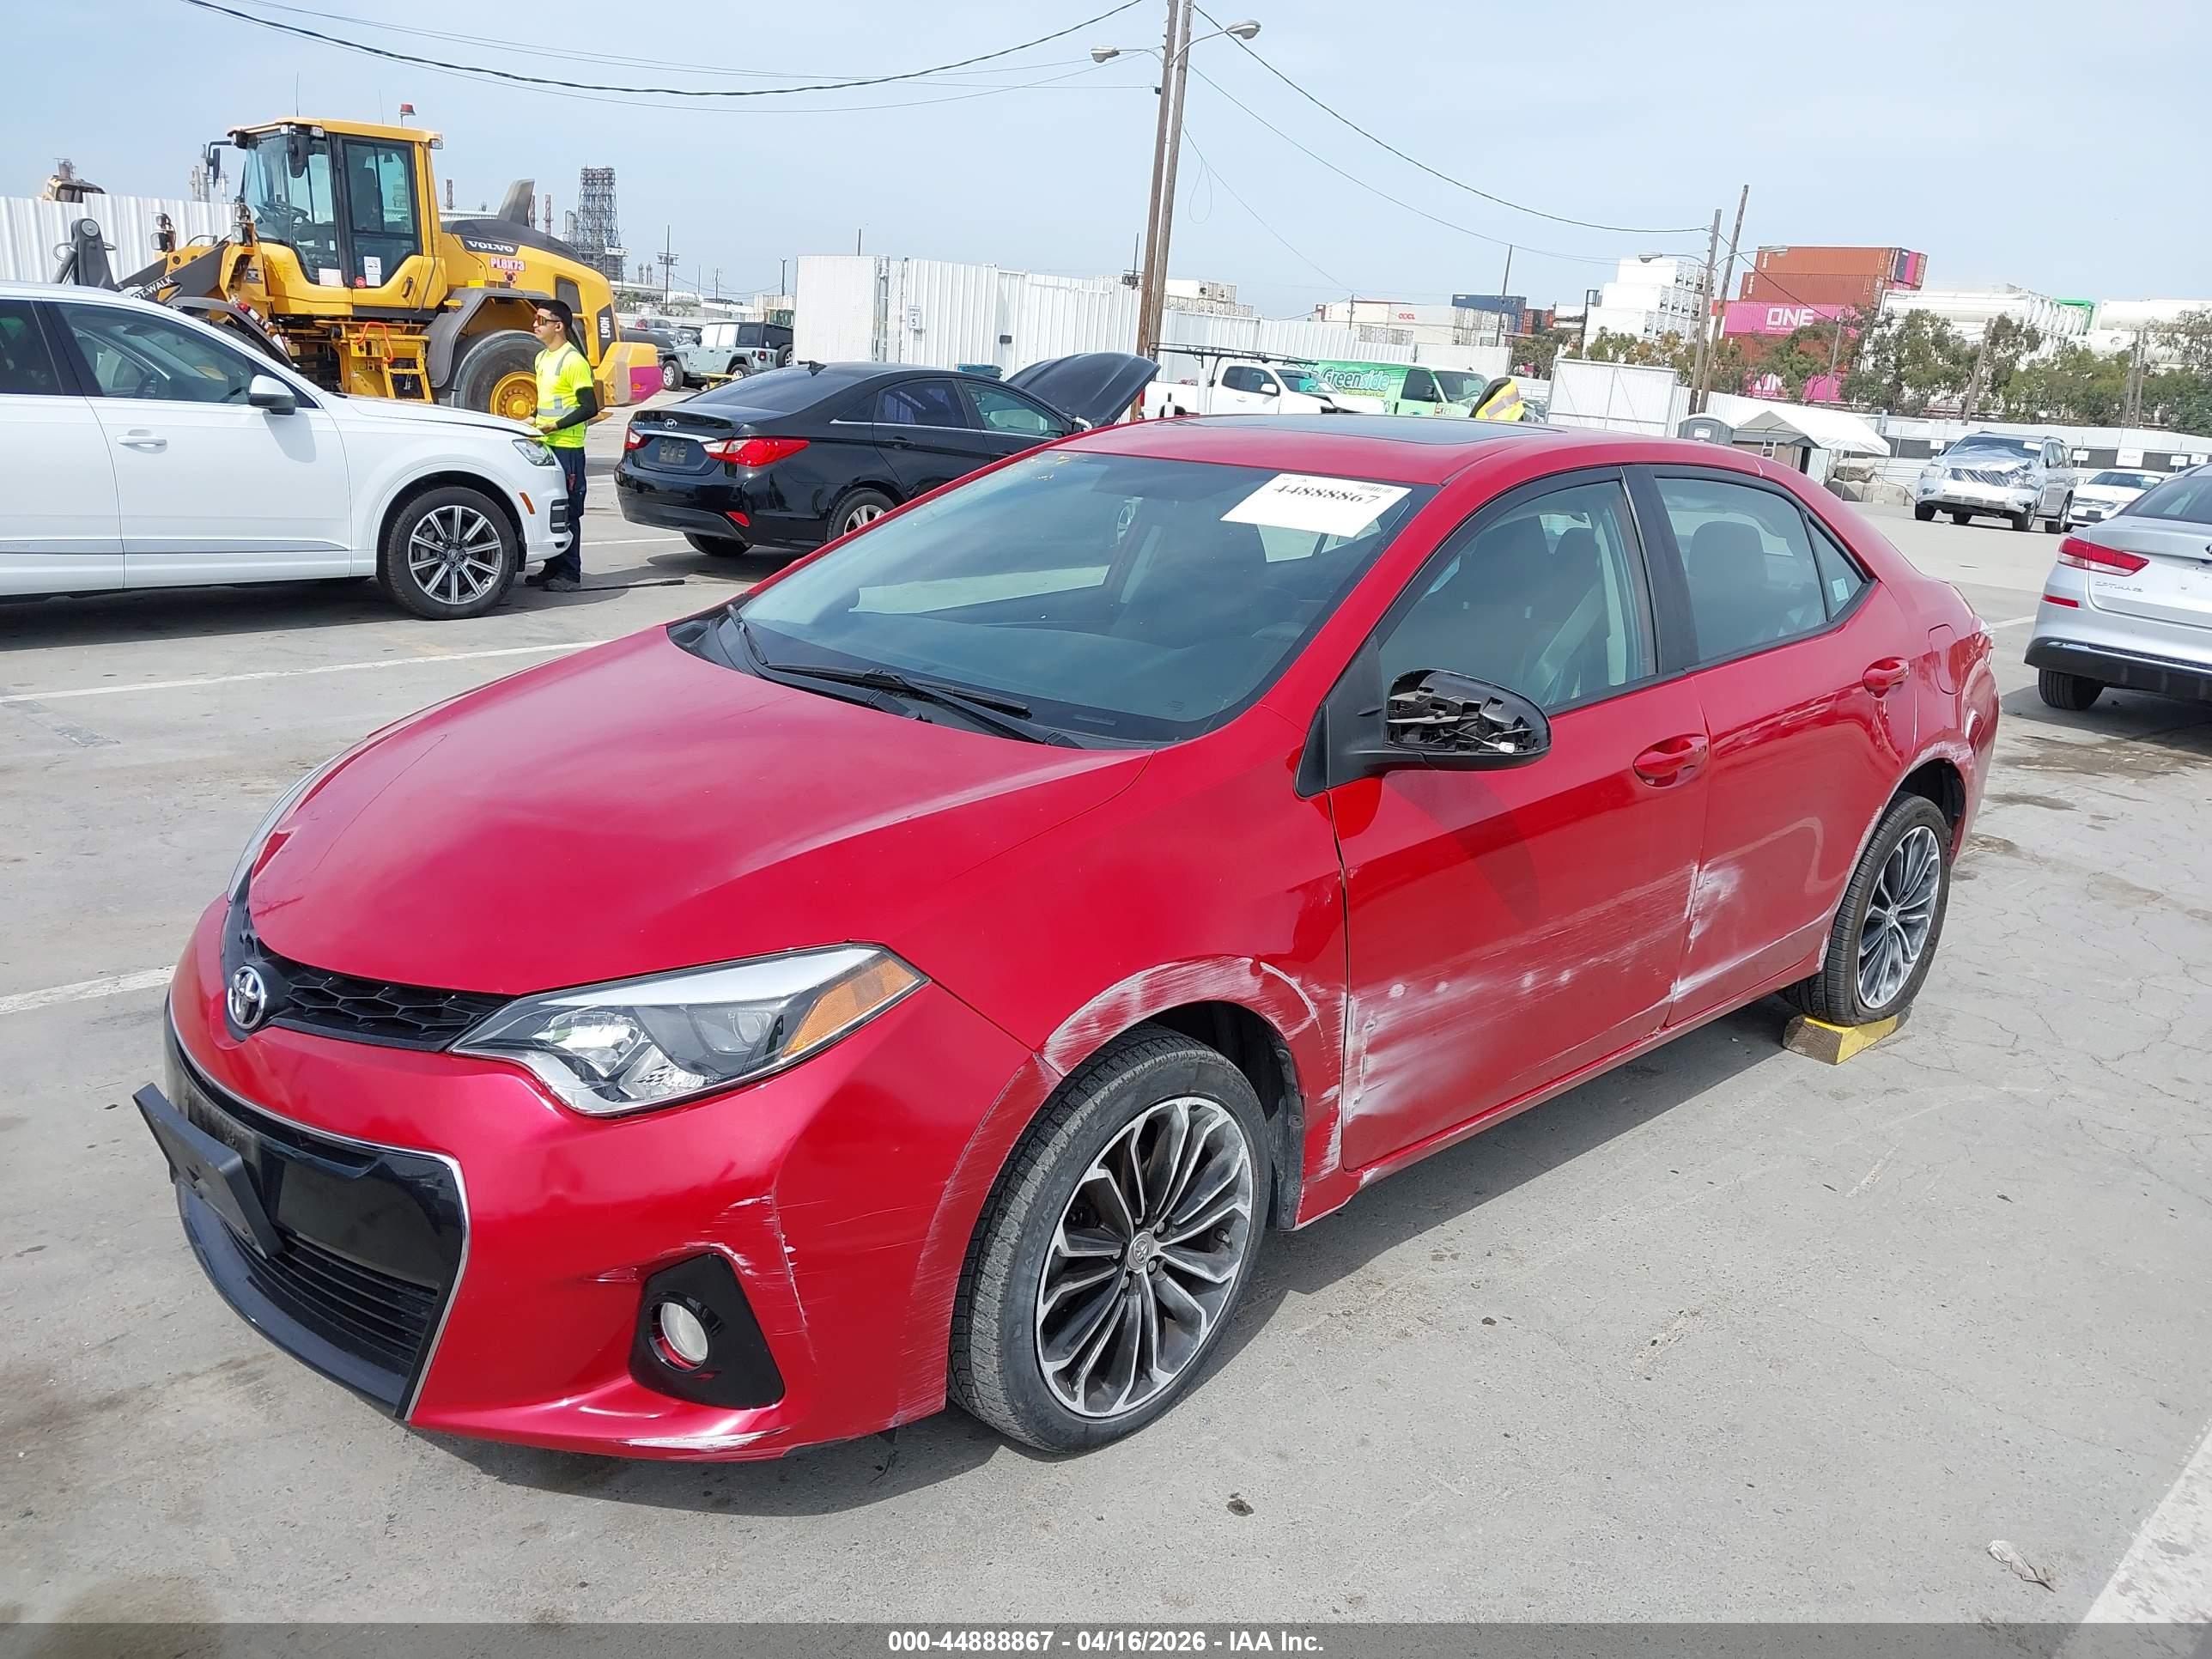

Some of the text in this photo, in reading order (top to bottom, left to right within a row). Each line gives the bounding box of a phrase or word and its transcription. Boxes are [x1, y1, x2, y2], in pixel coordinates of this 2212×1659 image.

[466, 240, 514, 252] VOLVO
[148, 276, 174, 293] WALK
[912, 318, 916, 326] 5
[1766, 308, 1814, 326] ONE
[599, 316, 611, 337] L90H
[1322, 368, 1389, 390] Greenside
[1273, 485, 1382, 504] 44888867
